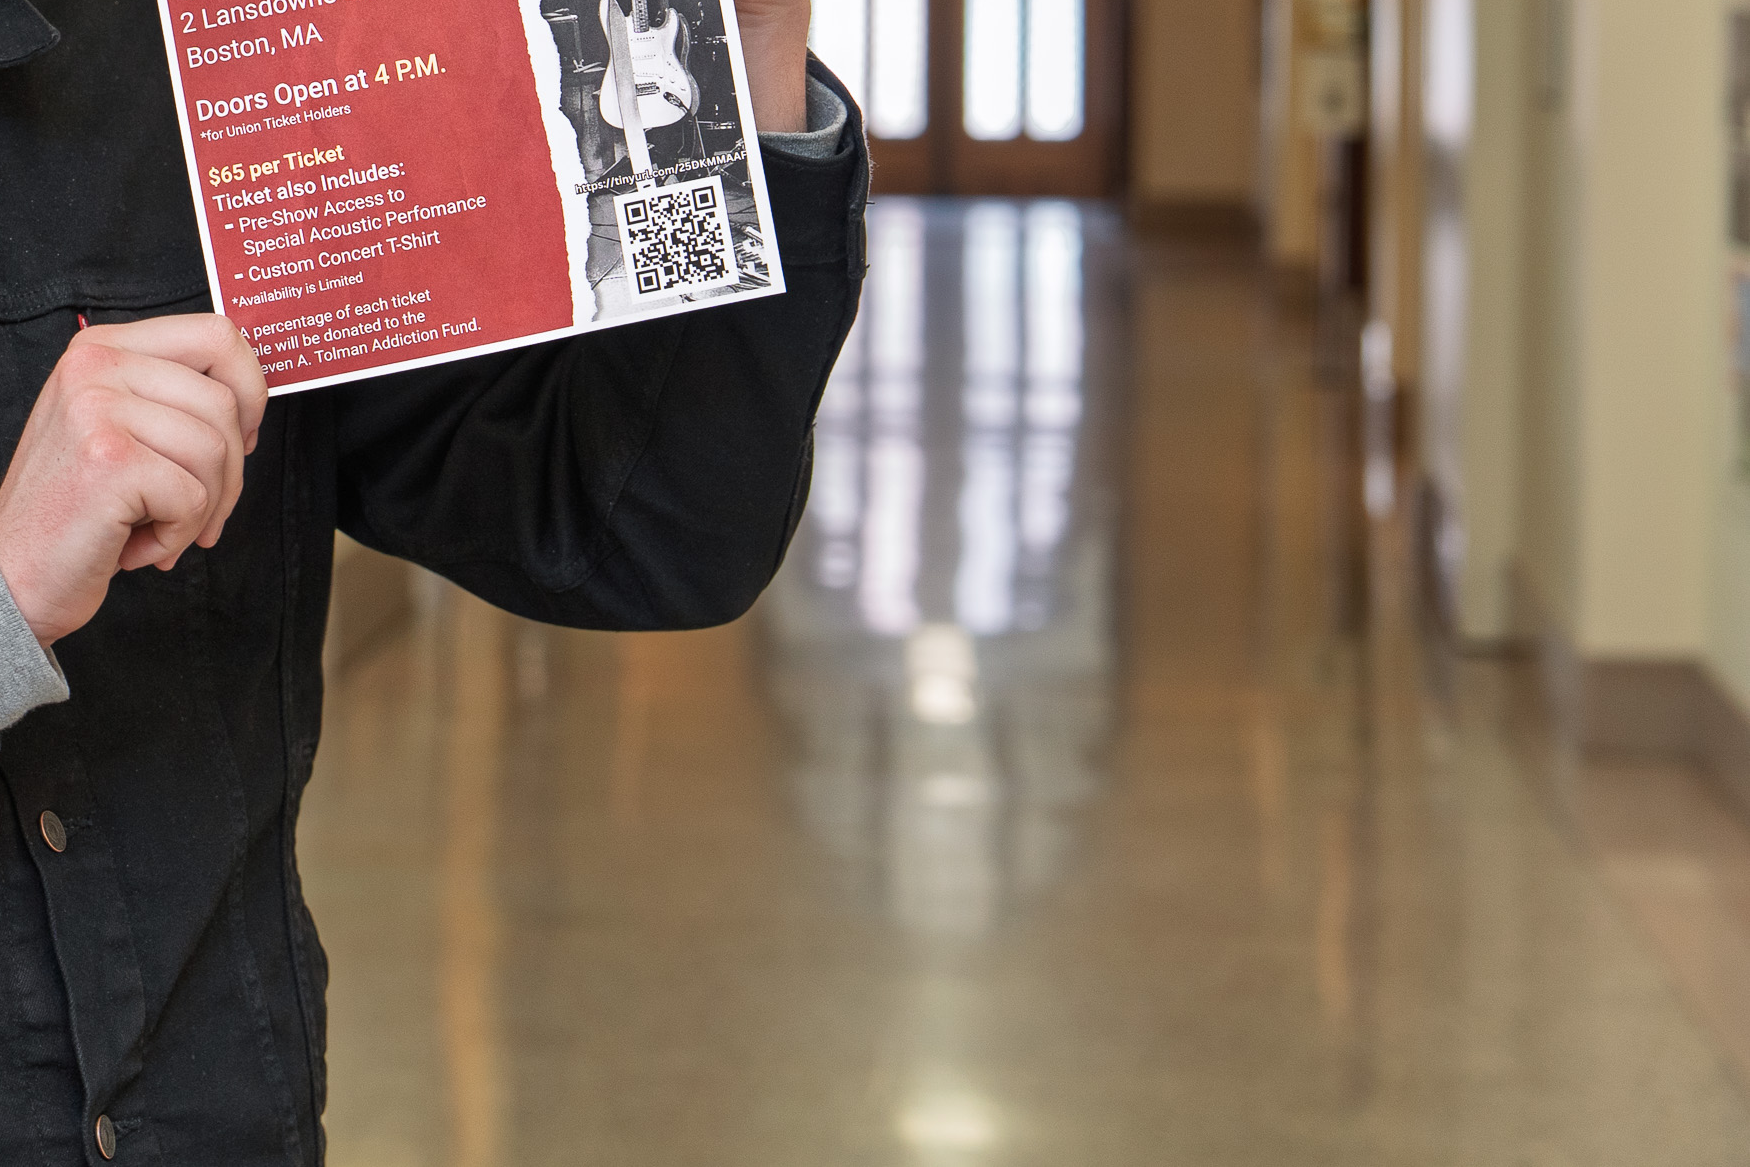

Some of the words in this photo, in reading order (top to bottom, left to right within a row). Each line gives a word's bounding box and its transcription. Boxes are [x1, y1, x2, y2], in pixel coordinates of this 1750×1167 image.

[180, 12, 197, 33] 2
[187, 37, 275, 68] Boston,
[280, 23, 323, 49] MA
[196, 92, 268, 121] Doors
[274, 79, 338, 107] Open
[344, 69, 369, 91] at
[375, 63, 390, 84] 4
[395, 53, 446, 81] P.M.
[226, 122, 262, 137] Union
[263, 113, 302, 129] Ticket
[303, 105, 351, 122] Holders
[209, 163, 245, 187] $65
[249, 160, 280, 182] per
[283, 145, 345, 170] Ticket
[212, 187, 273, 211] Ticket
[277, 180, 316, 200] also
[320, 162, 405, 191] Includes:
[239, 206, 318, 233] Pre-Show
[324, 194, 384, 216] Access
[387, 189, 405, 203] to
[243, 229, 305, 257] Special
[310, 216, 382, 243] Acoustic
[385, 196, 486, 227] Perfomance
[248, 259, 314, 281] Custom
[318, 242, 384, 267] Concert
[386, 230, 441, 253] T-Shirt
[305, 283, 316, 294] is
[318, 271, 363, 291] Limited
[252, 343, 271, 357] ale
[274, 335, 299, 352] will
[302, 334, 320, 346] be
[323, 318, 382, 342] donated
[384, 317, 399, 329] to
[402, 311, 425, 325] the
[253, 312, 333, 341] percentage
[336, 304, 350, 319] of
[355, 297, 389, 316] each
[391, 289, 431, 308] ticket
[260, 359, 293, 374] even
[297, 354, 311, 367] A.
[314, 344, 367, 364] Tolman
[371, 328, 439, 353] Addiction
[441, 317, 482, 338] Fund.
